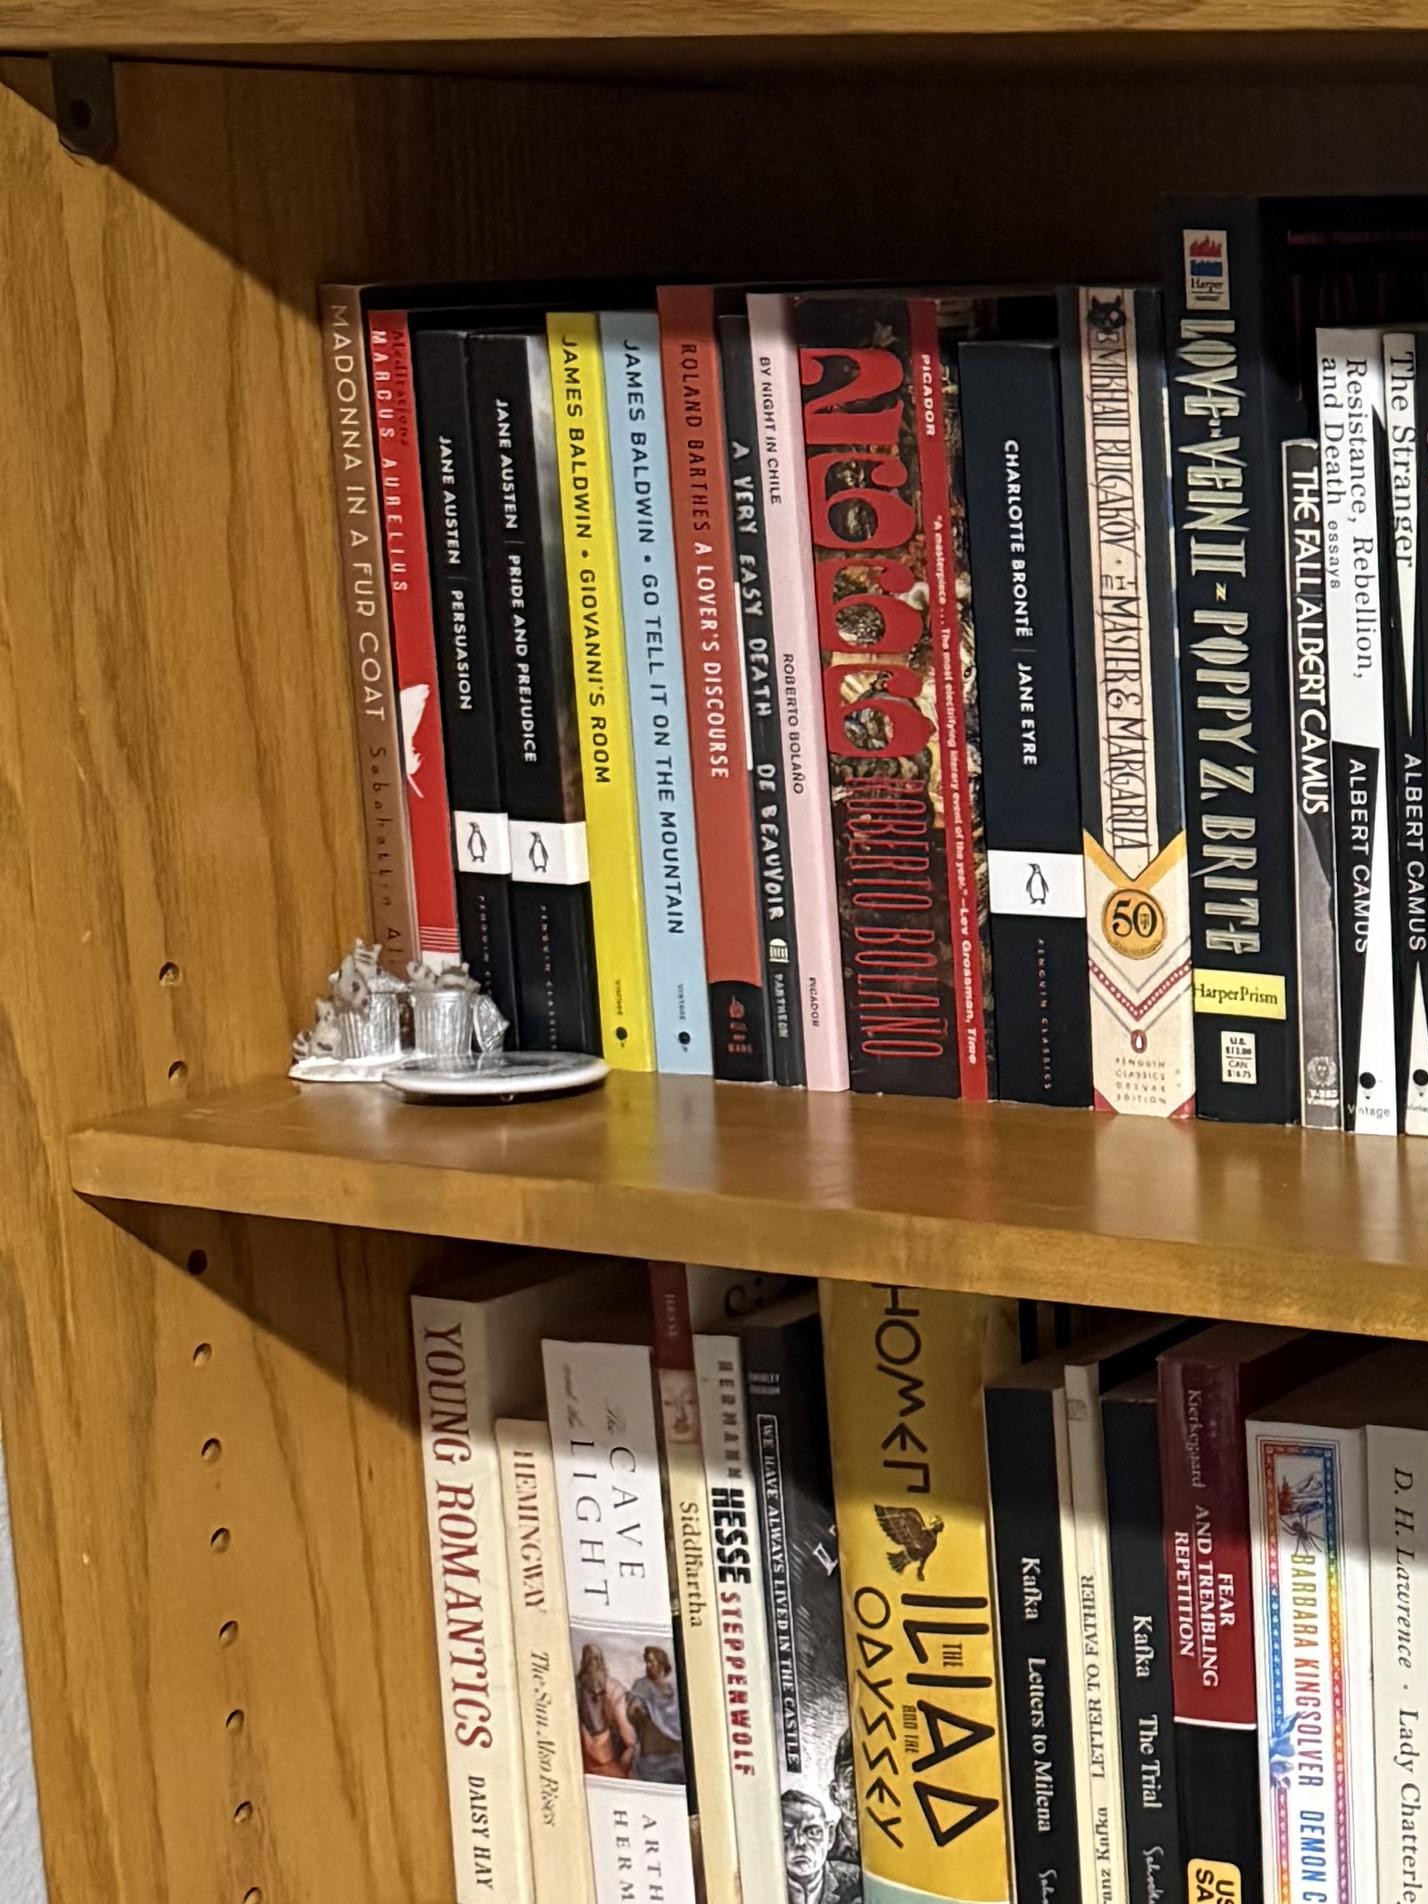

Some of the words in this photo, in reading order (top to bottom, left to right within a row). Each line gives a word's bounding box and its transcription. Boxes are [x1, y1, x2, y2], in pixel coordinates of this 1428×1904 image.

[561, 336, 582, 418] JAMES
[920, 354, 936, 437] PICADOR
[568, 426, 594, 539] BALDWIN
[1004, 439, 1027, 553] CHARLOTTE
[1011, 558, 1034, 637] BRONTË
[579, 569, 606, 717] GIOVANNI'S
[1017, 663, 1037, 715] JANE
[590, 715, 612, 784] ROOM
[1020, 722, 1038, 766] EYRE
[1404, 753, 1423, 853] ALBERT
[1406, 861, 1427, 952] CAMUS
[1195, 981, 1278, 1006] HarperPrism
[423, 1322, 473, 1466] YOUNG
[569, 1439, 610, 1607] LIGHT
[608, 1445, 646, 1580] CAVE
[710, 1486, 751, 1585] HESSE
[436, 1480, 494, 1750] ROMANTICS
[1132, 1614, 1154, 1679] Kafka
[719, 1591, 756, 1777] STEPPENWOLF
[1136, 1714, 1159, 1756] The
[468, 1774, 490, 1839] DAISY
[1139, 1759, 1164, 1810] Trial
[472, 1845, 495, 1891] HAY
